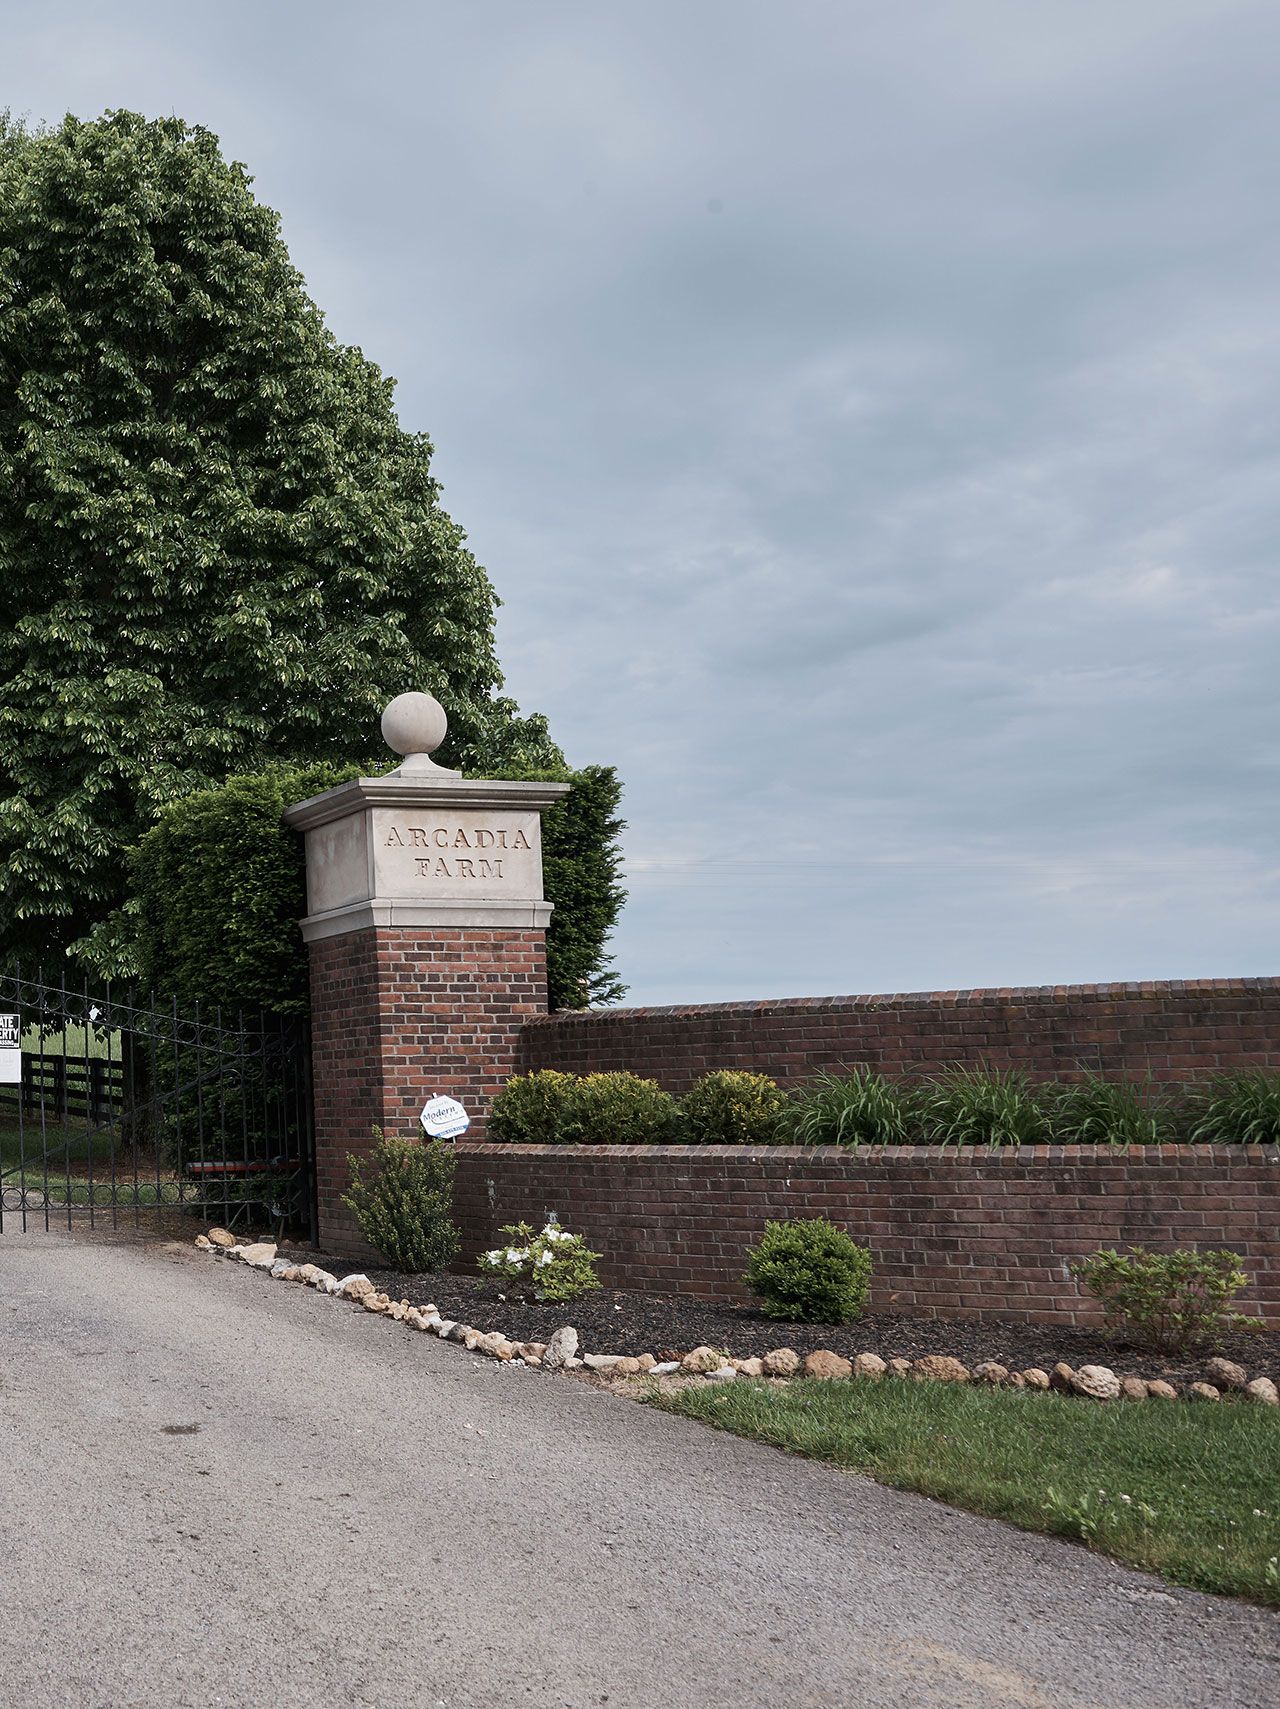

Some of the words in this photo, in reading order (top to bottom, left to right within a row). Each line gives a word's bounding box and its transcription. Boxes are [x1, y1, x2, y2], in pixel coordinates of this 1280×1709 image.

[384, 827, 531, 850] ARCADIA
[414, 858, 504, 878] FARM
[423, 1106, 456, 1121] Modern
